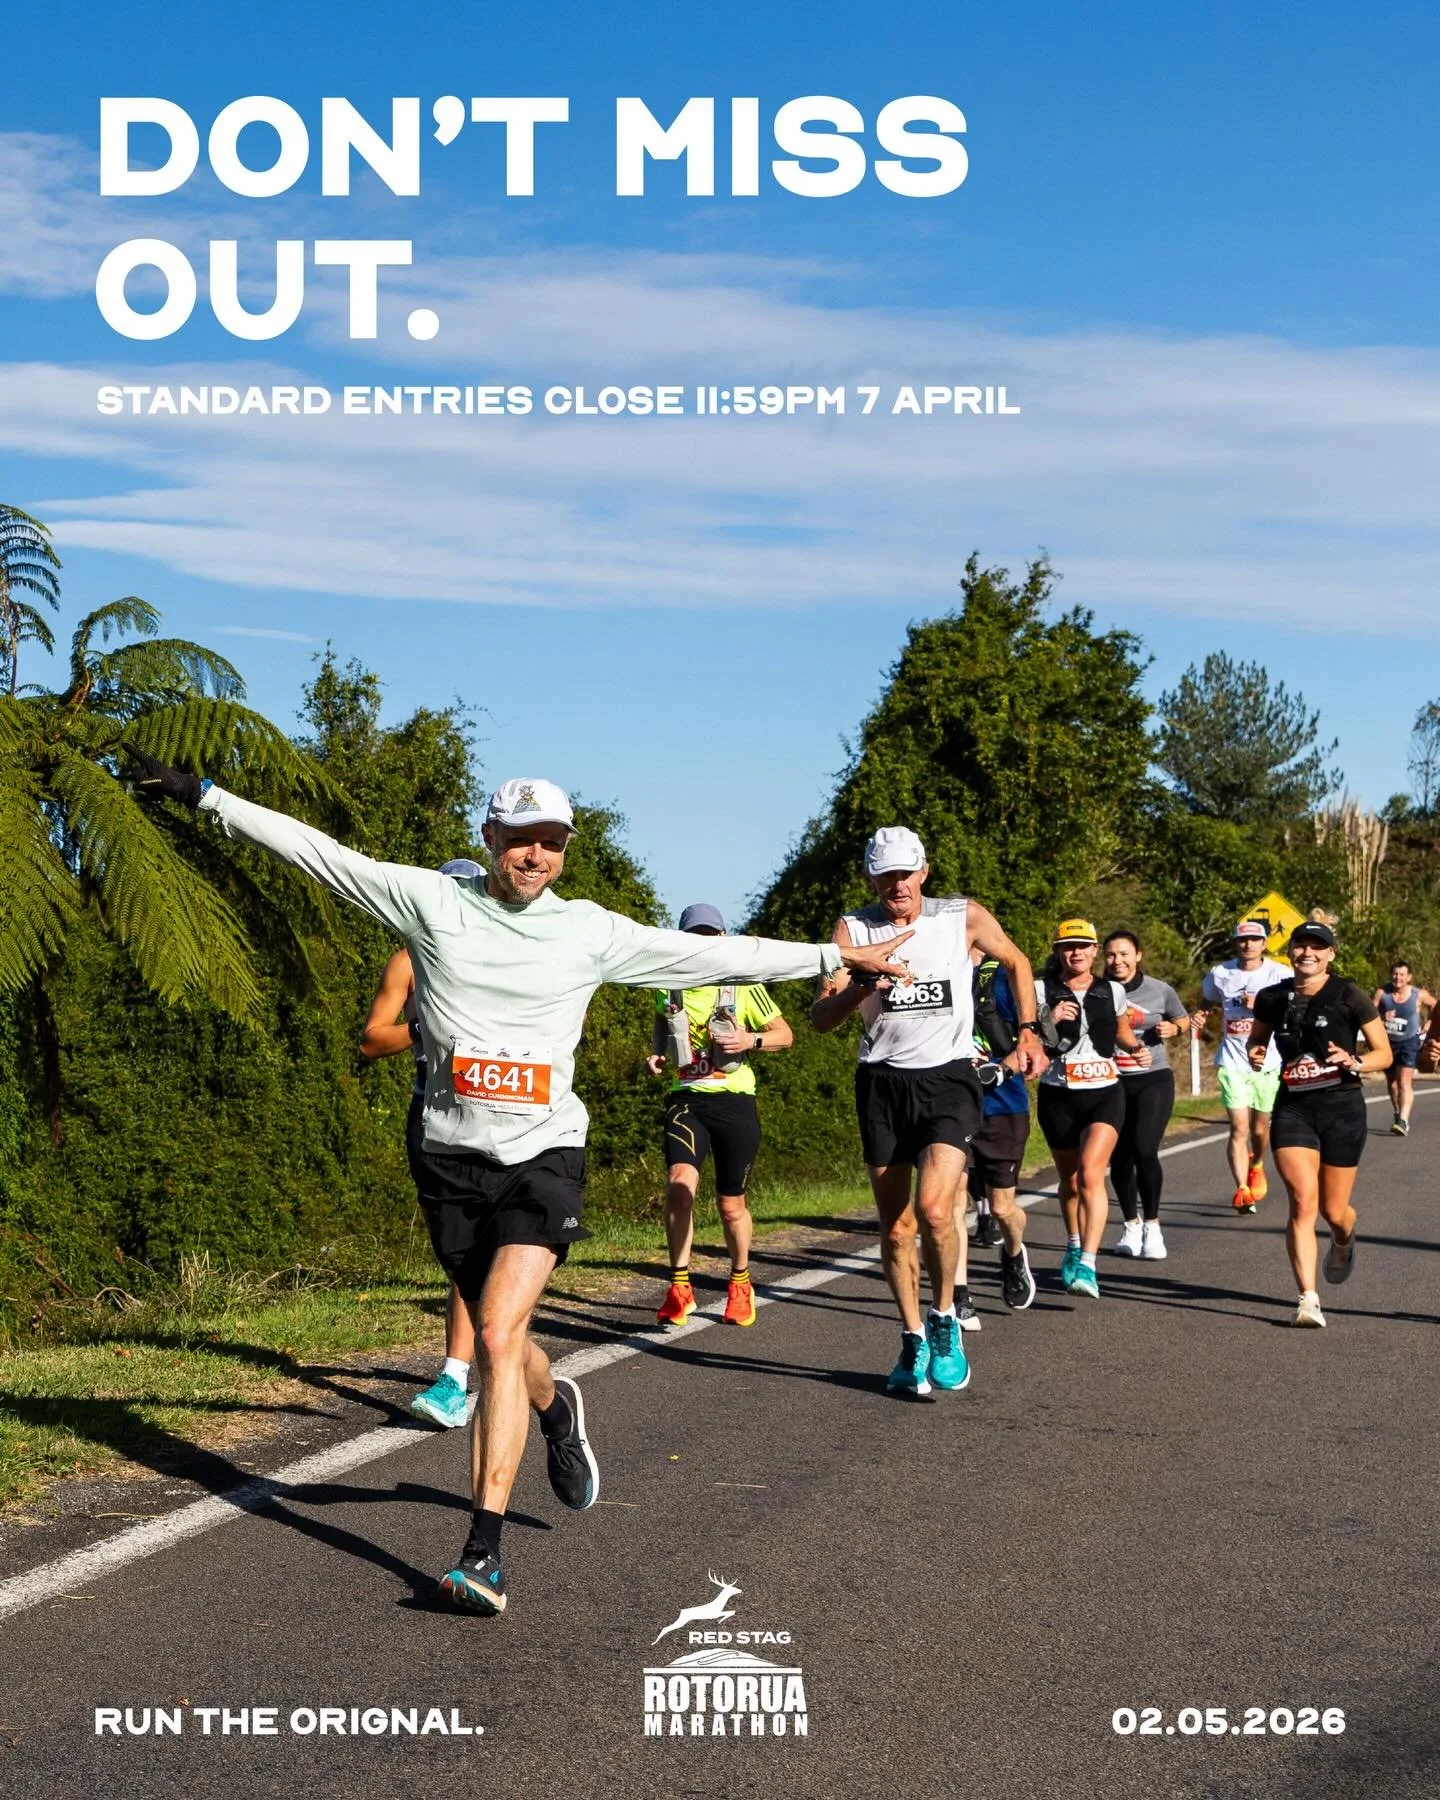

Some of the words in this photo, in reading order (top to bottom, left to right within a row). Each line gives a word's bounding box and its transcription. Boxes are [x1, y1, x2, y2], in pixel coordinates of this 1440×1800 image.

[1230, 1020, 1253, 1032] 420
[1072, 1062, 1110, 1078] 4900
[464, 1062, 534, 1093] 4641
[466, 1089, 487, 1098] DAVID
